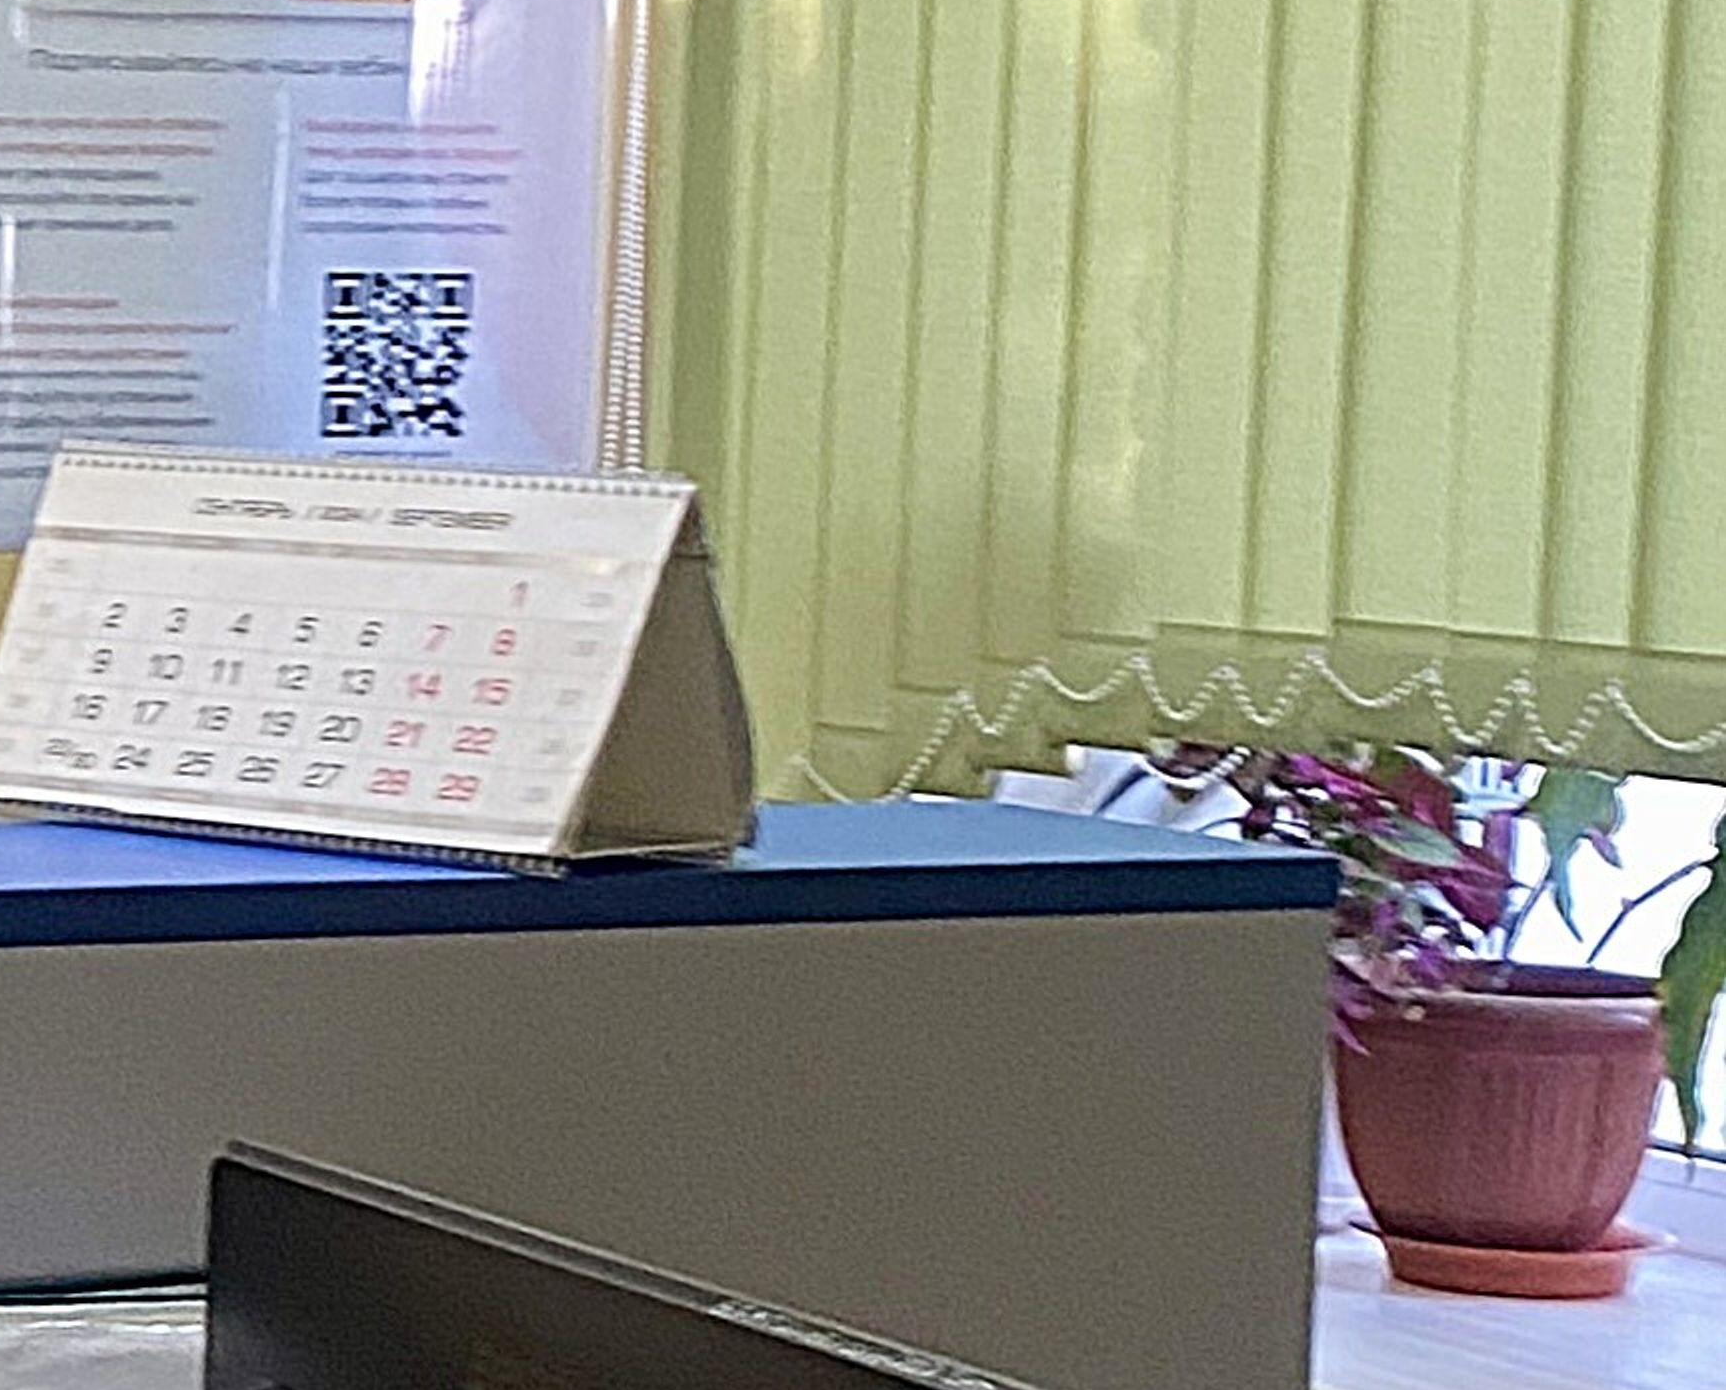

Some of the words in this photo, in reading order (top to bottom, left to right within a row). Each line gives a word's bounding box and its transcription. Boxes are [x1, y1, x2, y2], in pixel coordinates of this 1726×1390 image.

[103, 602, 127, 628] 2
[165, 606, 189, 633] 3
[228, 612, 254, 634] 4
[294, 616, 319, 643] 5
[358, 621, 384, 647] 6
[424, 624, 451, 651] 7
[492, 628, 517, 656] 8
[91, 649, 113, 674] 9
[151, 654, 184, 680] 10
[212, 659, 244, 685] 11
[277, 664, 310, 690] 12
[341, 669, 376, 696] 13
[407, 673, 442, 700] 14
[474, 678, 513, 705] 15
[73, 694, 108, 720] 16
[133, 700, 170, 725] 17
[197, 705, 232, 731] 18
[261, 711, 297, 737] 19
[319, 714, 363, 742] 20
[384, 720, 427, 747] 21
[452, 725, 498, 755] 22
[112, 744, 153, 770] 24
[173, 750, 215, 777] 25
[236, 756, 280, 782] 26
[301, 762, 346, 788] 27
[367, 767, 412, 796] 28
[436, 773, 481, 801] 29
